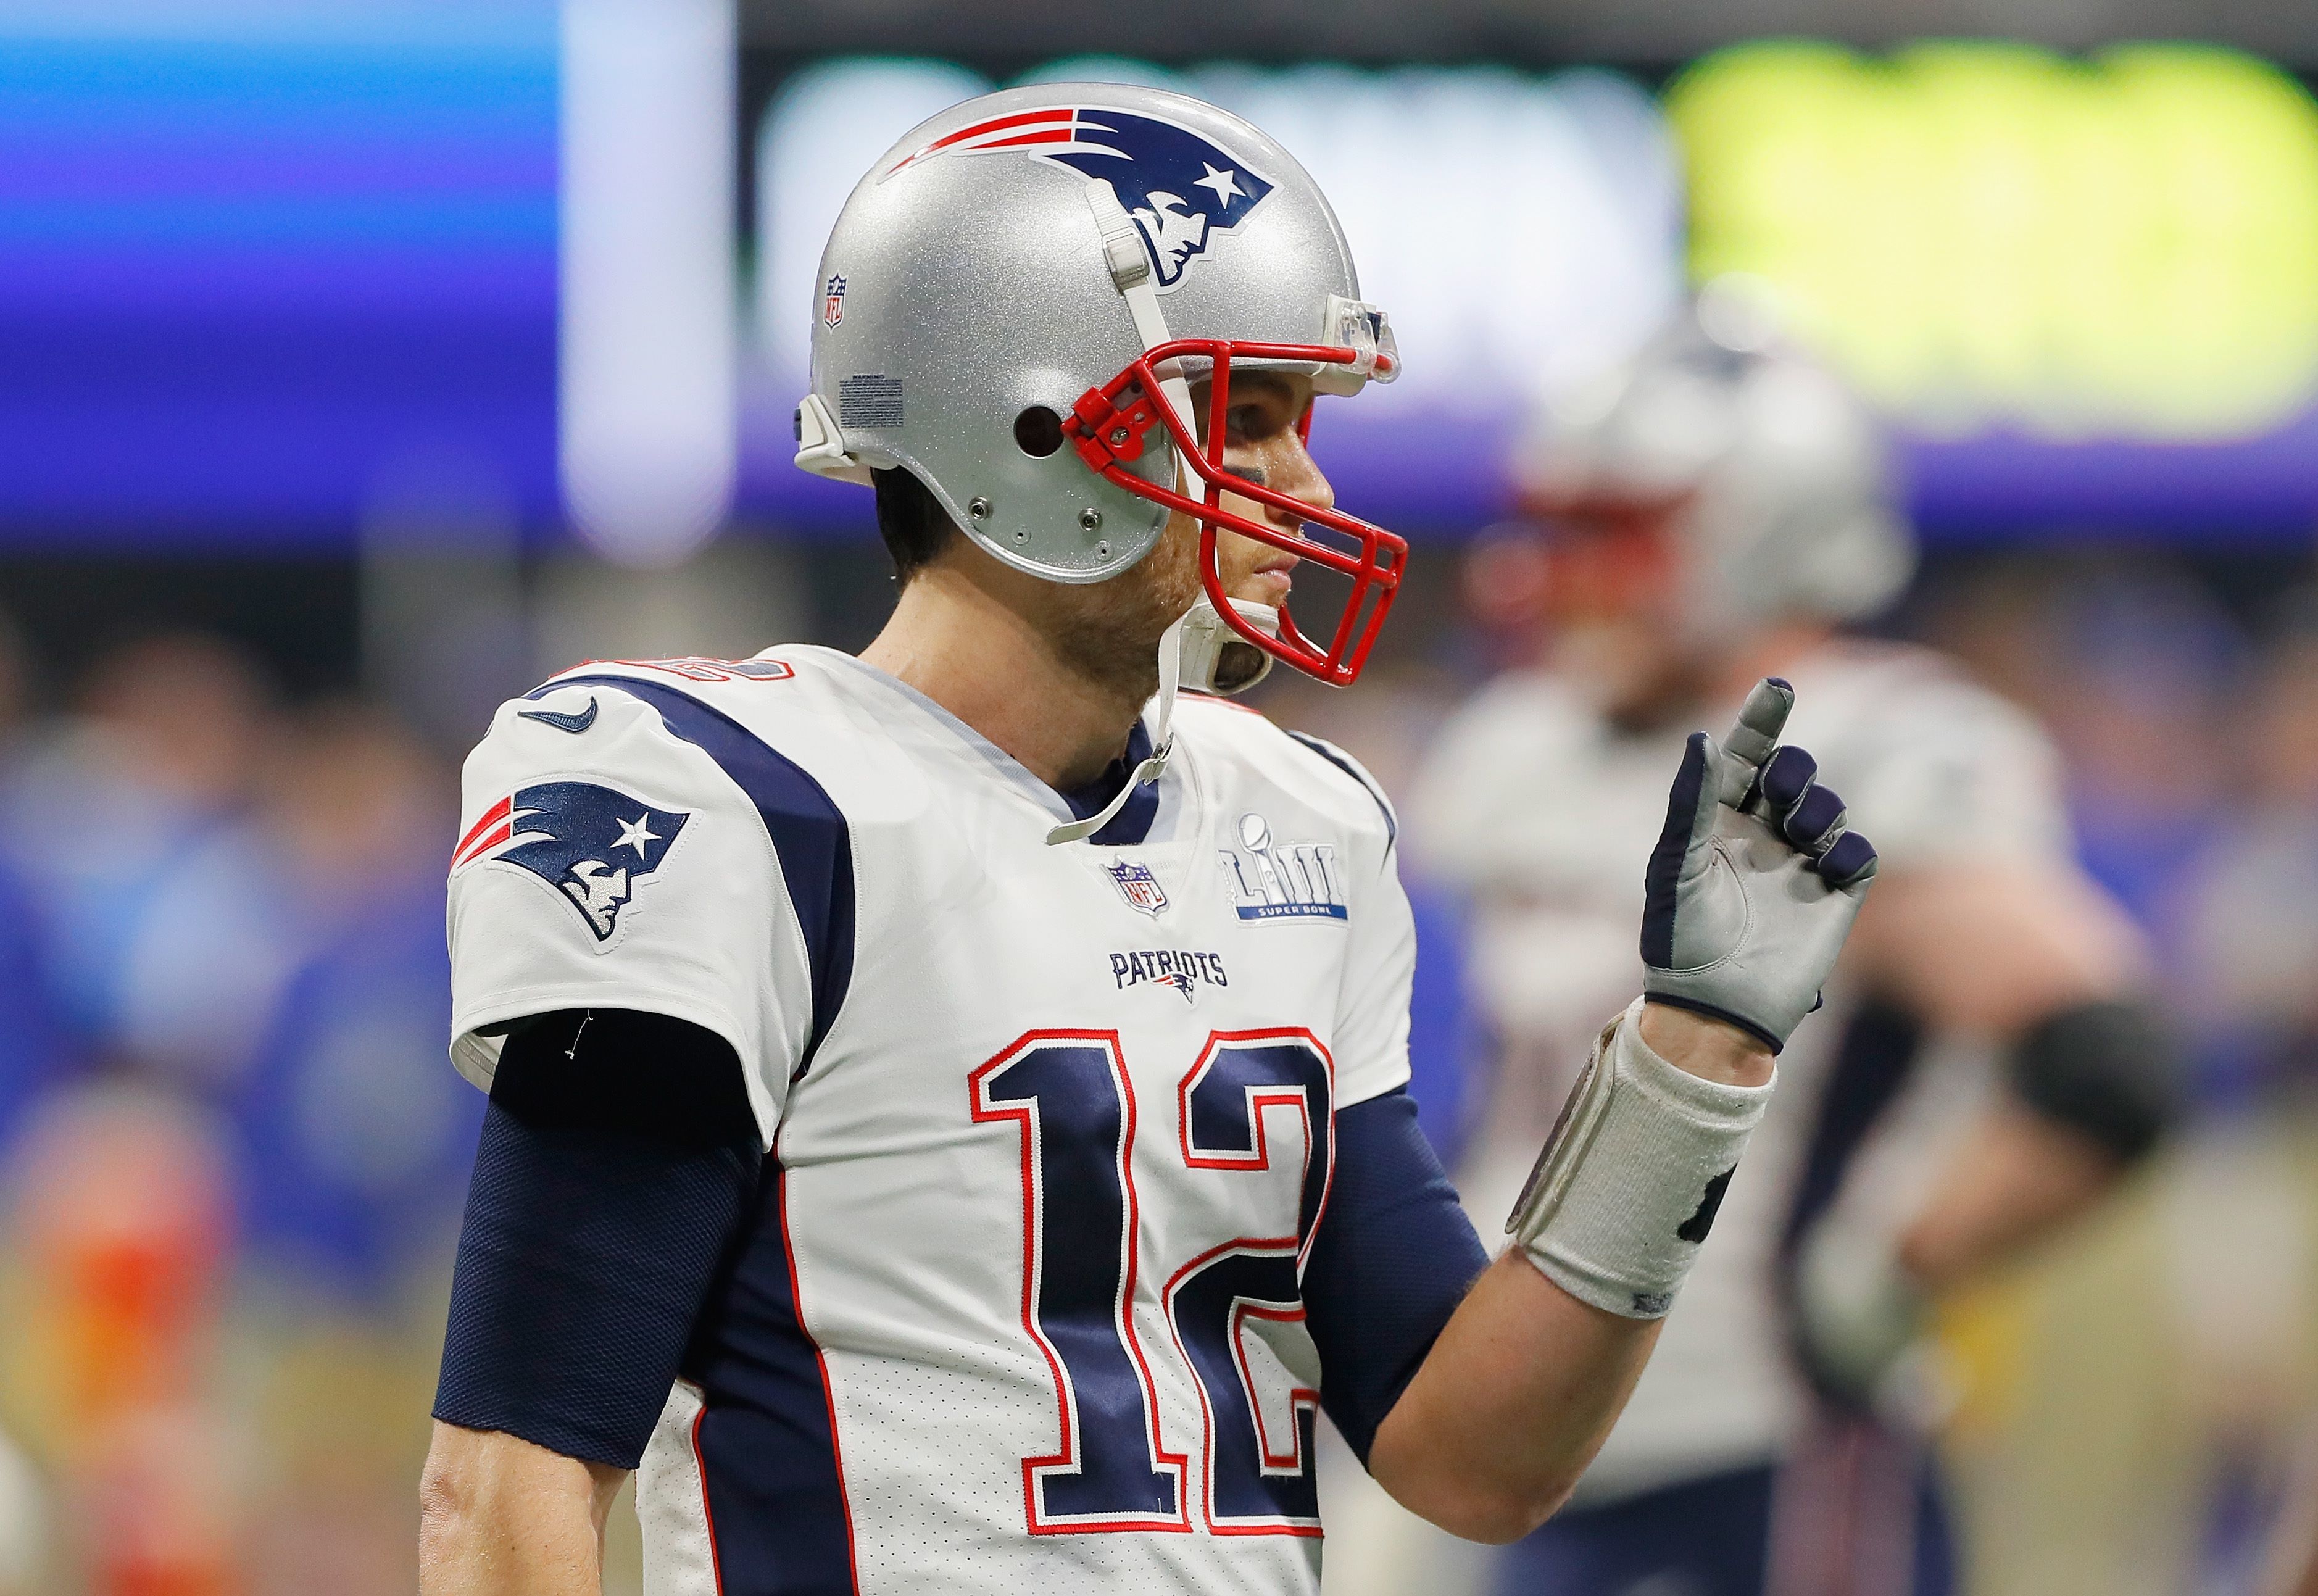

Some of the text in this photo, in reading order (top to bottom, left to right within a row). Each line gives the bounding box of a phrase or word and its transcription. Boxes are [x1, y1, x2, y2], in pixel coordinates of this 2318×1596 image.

[825, 297, 842, 323] NFL
[1124, 882, 1163, 905] NFL
[1258, 905, 1332, 917] SUPER BOWL
[1109, 950, 1228, 989] PATRIOTS
[967, 1028, 1336, 1537] 12
